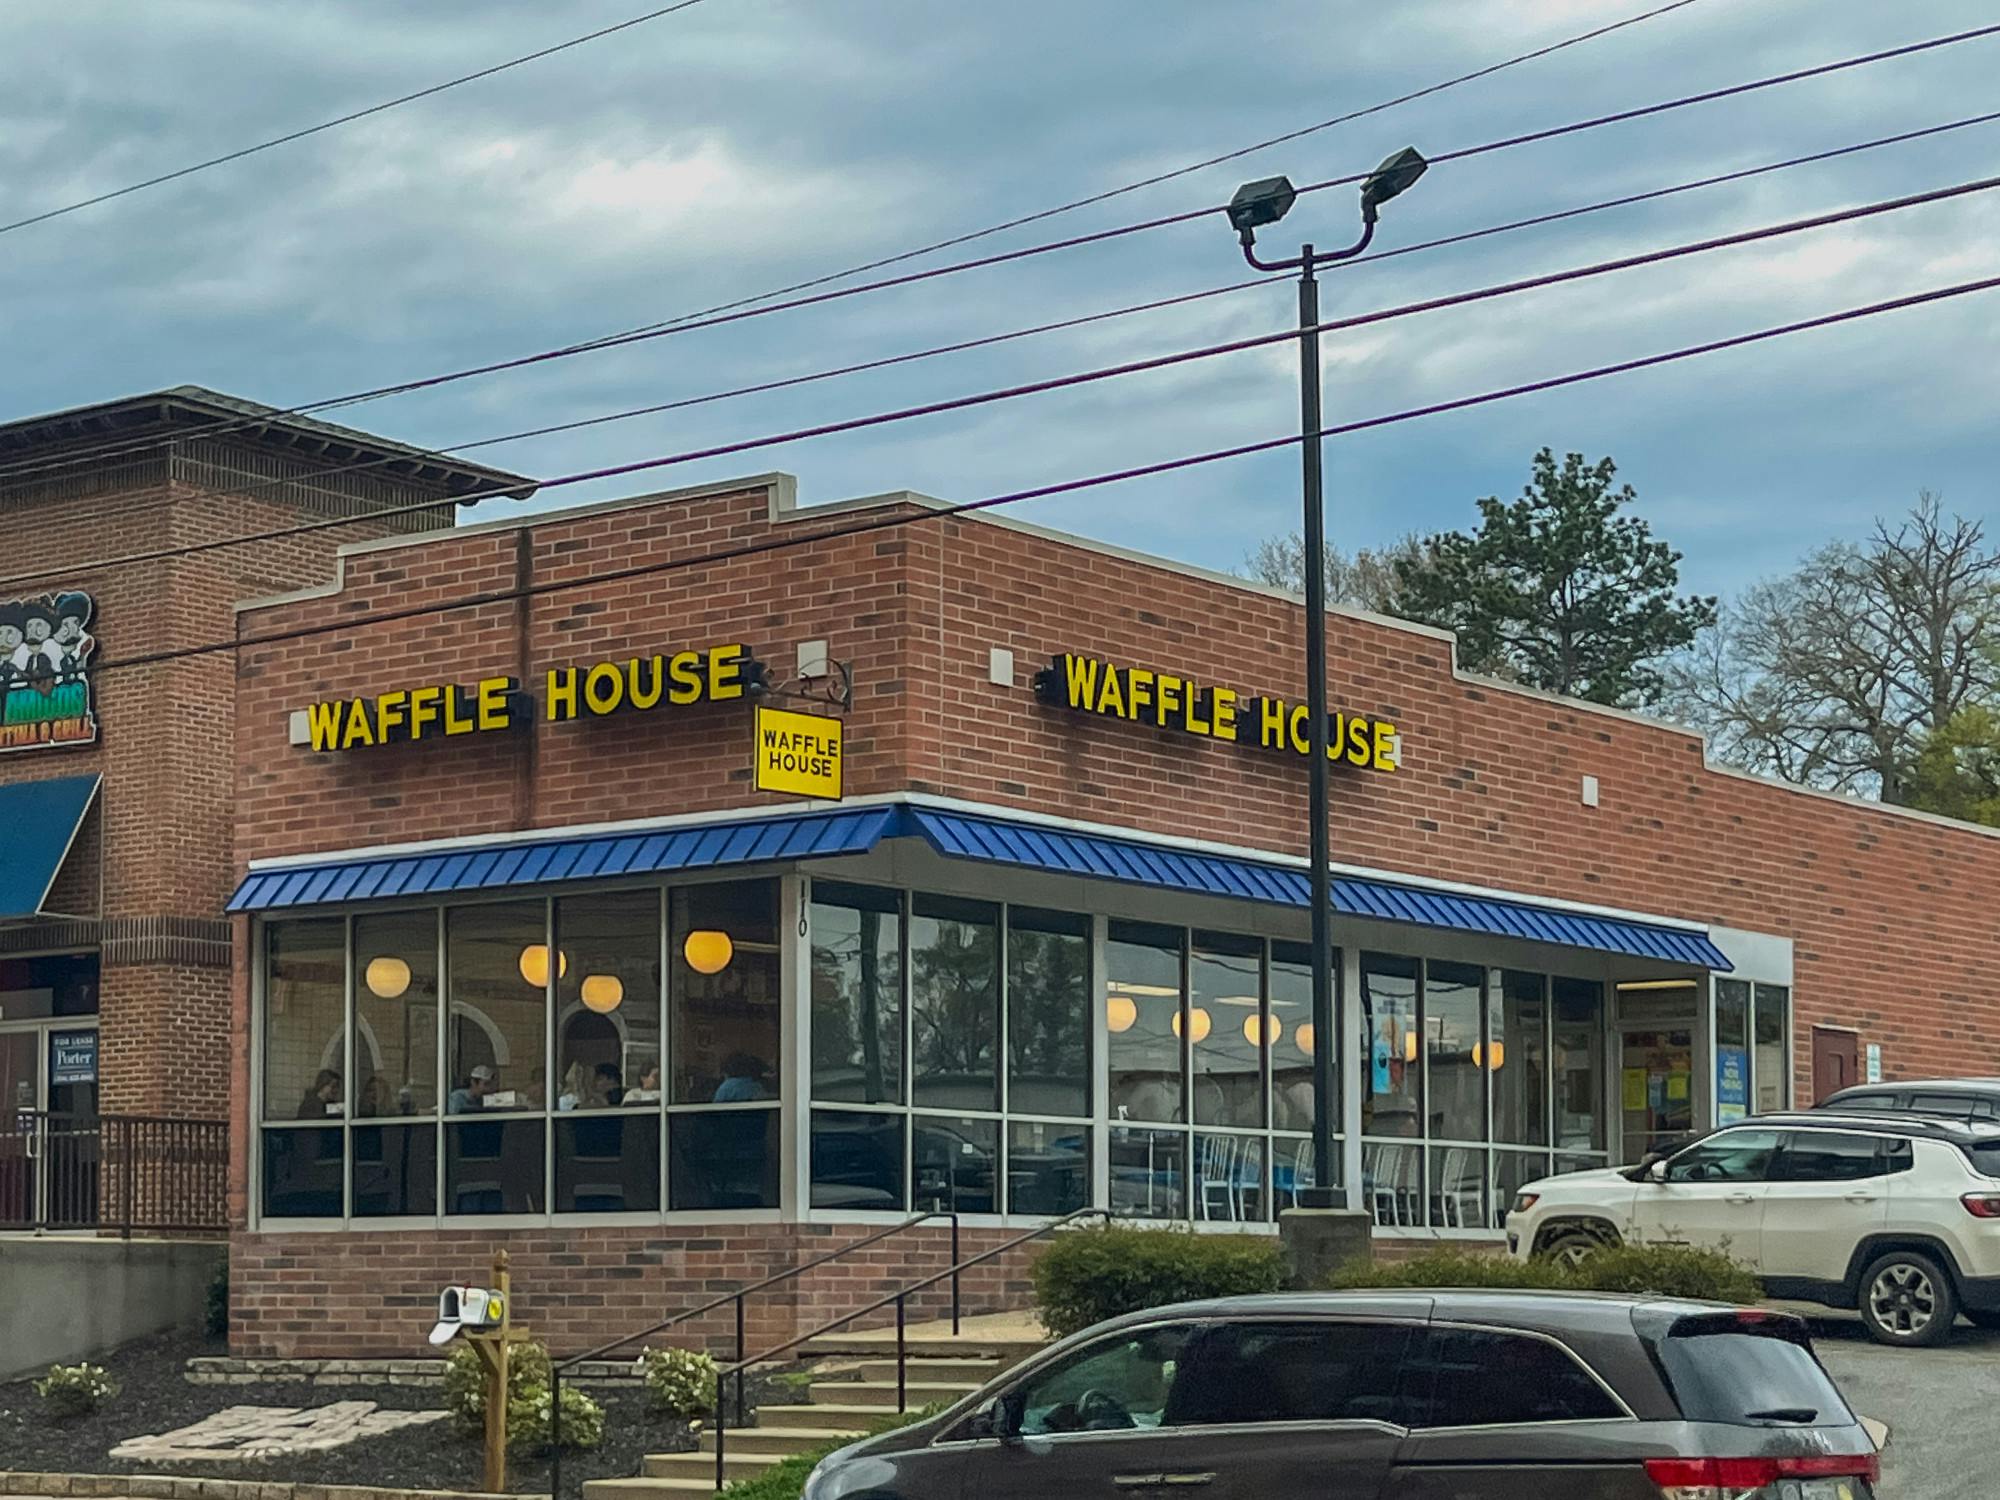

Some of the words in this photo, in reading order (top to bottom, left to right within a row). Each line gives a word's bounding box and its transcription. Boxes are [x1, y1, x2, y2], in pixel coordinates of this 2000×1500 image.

[308, 676, 510, 751] WAFFLE
[546, 642, 745, 722] HOUSE
[1064, 653, 1237, 740] WAFFLE
[1260, 696, 1397, 773] HOUSE
[53, 717, 92, 739] GRILL
[764, 729, 838, 757] WAFFLE
[769, 751, 832, 777] HOUSE
